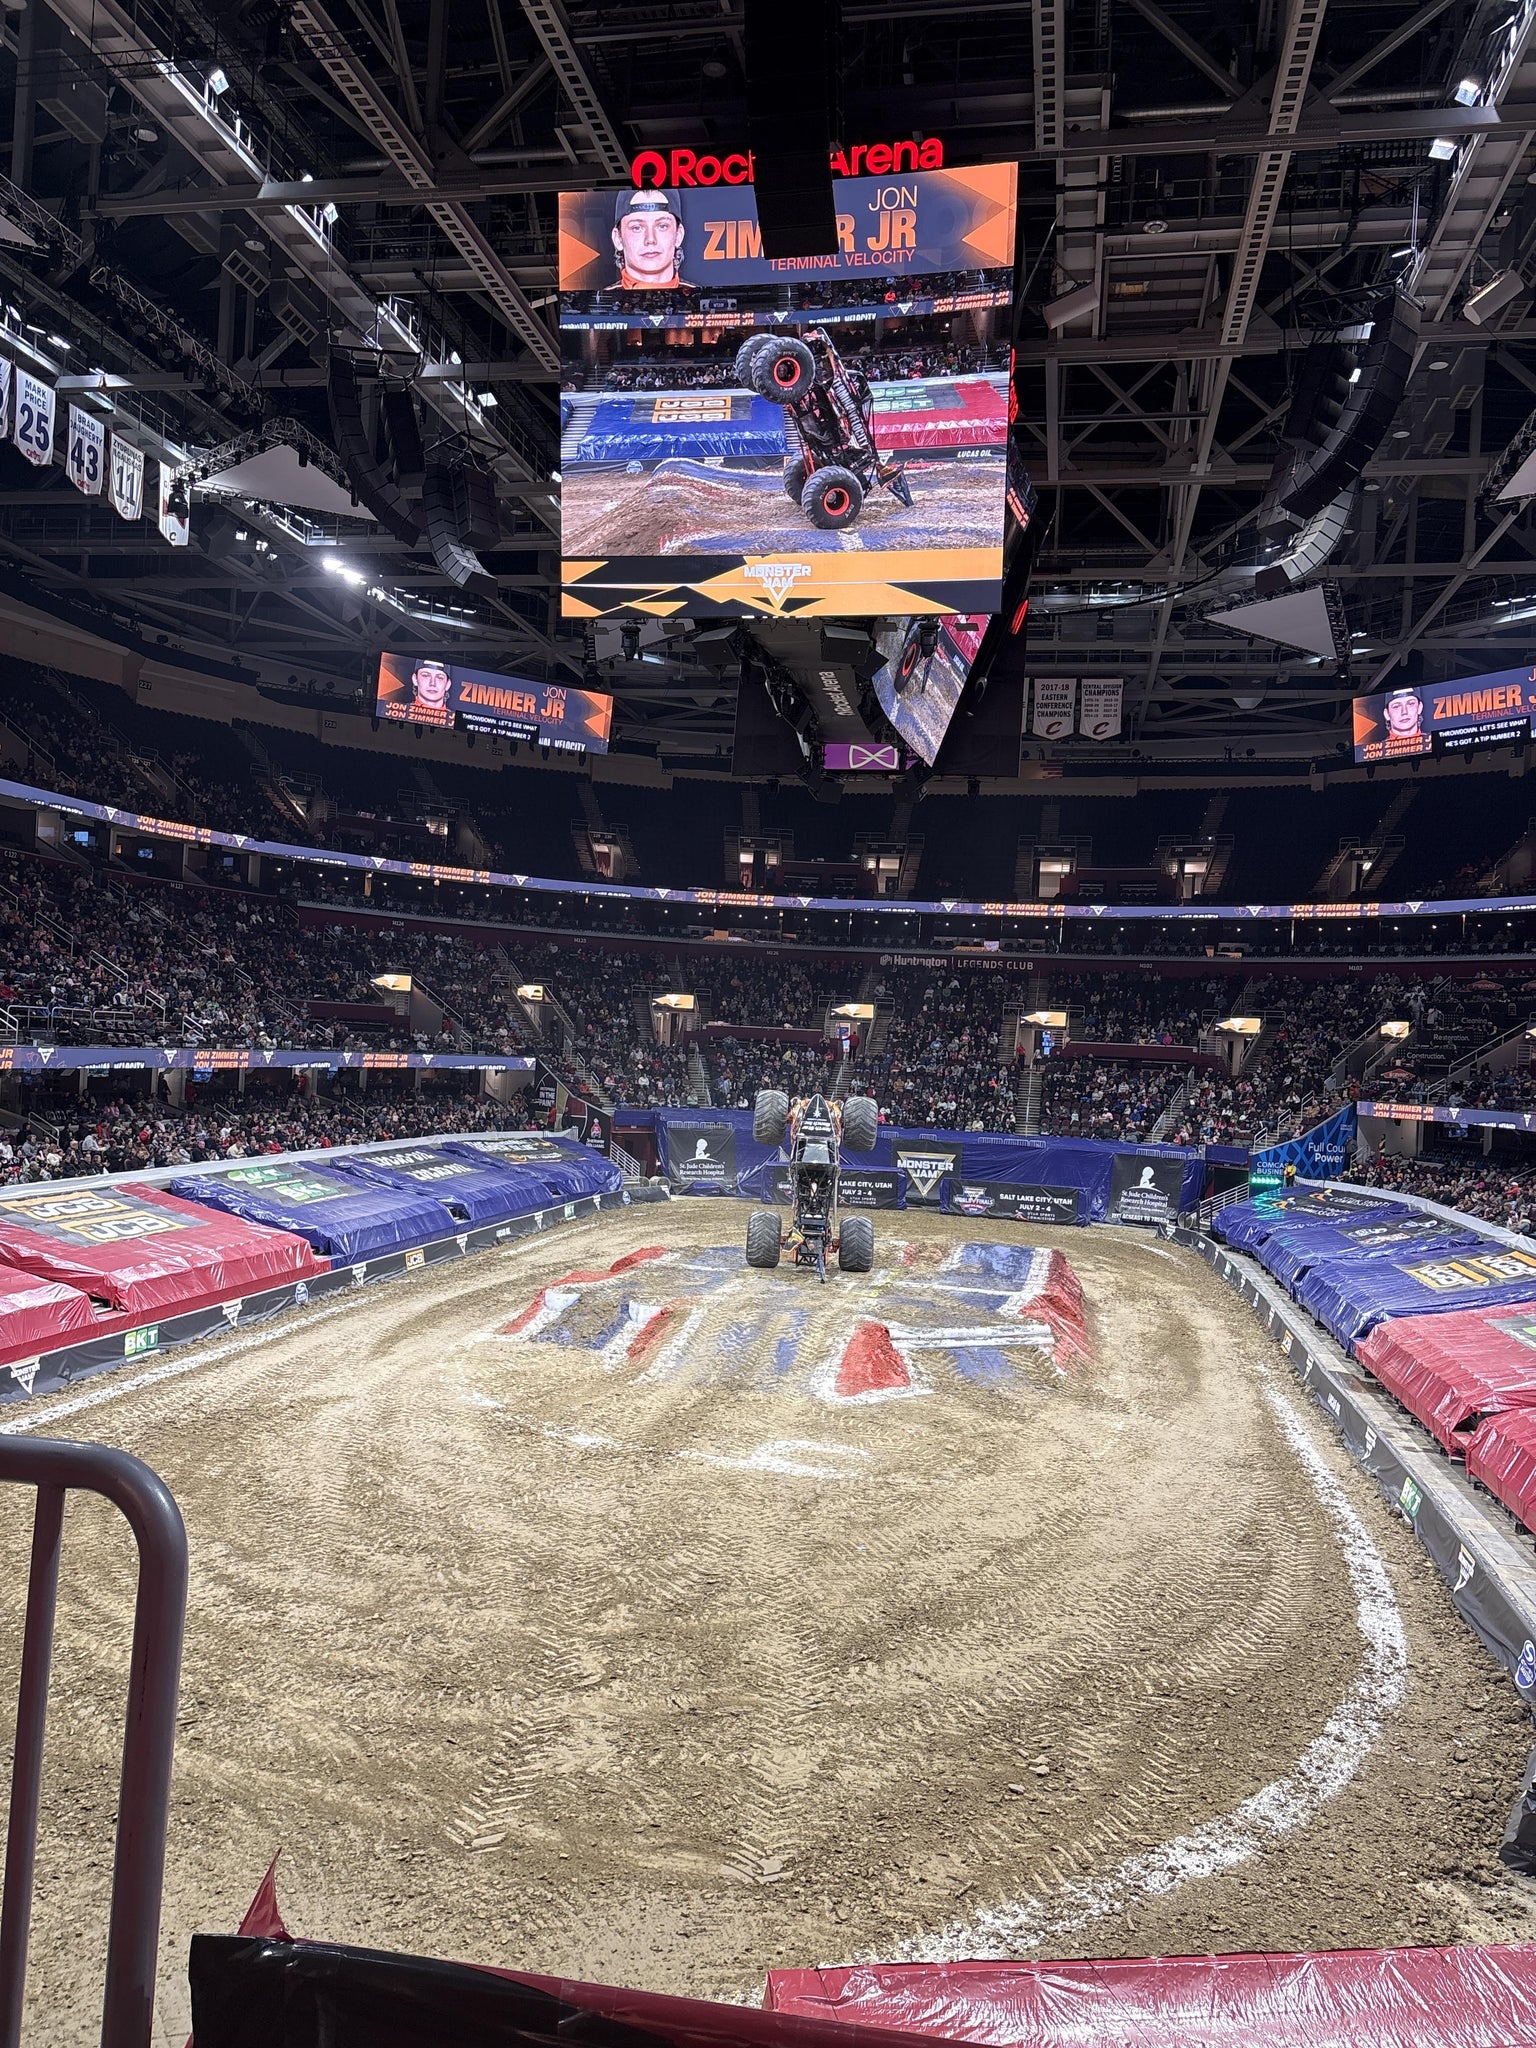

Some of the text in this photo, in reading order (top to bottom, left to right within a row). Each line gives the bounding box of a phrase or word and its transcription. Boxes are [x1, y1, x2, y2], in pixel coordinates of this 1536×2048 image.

[868, 185, 918, 211] JON
[703, 208, 917, 260] ZIMR JR
[770, 249, 916, 271] TERMINAL VELOCITY
[933, 303, 954, 313] JON
[955, 300, 993, 310] ZIMMER
[741, 318, 755, 326] JR
[25, 380, 46, 399] MARK
[25, 391, 47, 410] PRICE
[19, 403, 50, 451] 25
[77, 413, 96, 432] BRAD
[71, 437, 99, 482] 43
[957, 449, 993, 458] LUCAS OIL
[116, 465, 136, 506] 11
[744, 565, 812, 577] MONSTER
[762, 577, 794, 588] JAM
[819, 671, 843, 692] Arena
[459, 680, 565, 719] ZIMMER JR
[543, 686, 567, 700] JON
[1041, 693, 1068, 701] EASTERN
[1433, 684, 1522, 720] ZIMMER
[385, 702, 447, 718] JON ZIMMER
[493, 707, 564, 725] TERMINAL VELOCITY
[1037, 710, 1071, 718] CHAMPIONS
[1471, 709, 1514, 721] TERMINAL
[385, 710, 446, 726] JON ZIMMER
[512, 721, 522, 729] SEE
[1480, 723, 1495, 732] LET'S
[1496, 721, 1508, 729] SEE
[1509, 718, 1527, 727] WHAT
[506, 730, 527, 740] NUMBER
[1490, 732, 1515, 740] NUMBER
[1363, 736, 1423, 751] JON ZIMMER
[1363, 744, 1423, 759] JON ZIMMER
[137, 815, 212, 836] JON ZIMMER JR
[409, 863, 490, 878] JON ZIMMER JR
[718, 892, 759, 900] ZIMMER
[1005, 903, 1048, 911] ZIMMER
[1315, 903, 1361, 911] ZIMMER
[1006, 960, 1034, 971] CLUB
[194, 1051, 249, 1060] JON ZIMMER JR
[1406, 1052, 1446, 1060] Construction.
[1373, 1103, 1434, 1114] JON ZIMMER JR
[1308, 1142, 1324, 1152] Full
[1314, 1153, 1344, 1163] Power
[897, 1160, 953, 1171] MONSTER
[912, 1169, 938, 1179] JAM
[857, 1181, 874, 1189] CITY,
[31, 1198, 116, 1217] JCB
[1121, 1197, 1168, 1208] Research Hospital
[88, 1216, 170, 1239] JCB
[408, 1254, 423, 1266] JCB
[125, 1328, 158, 1353] BKT
